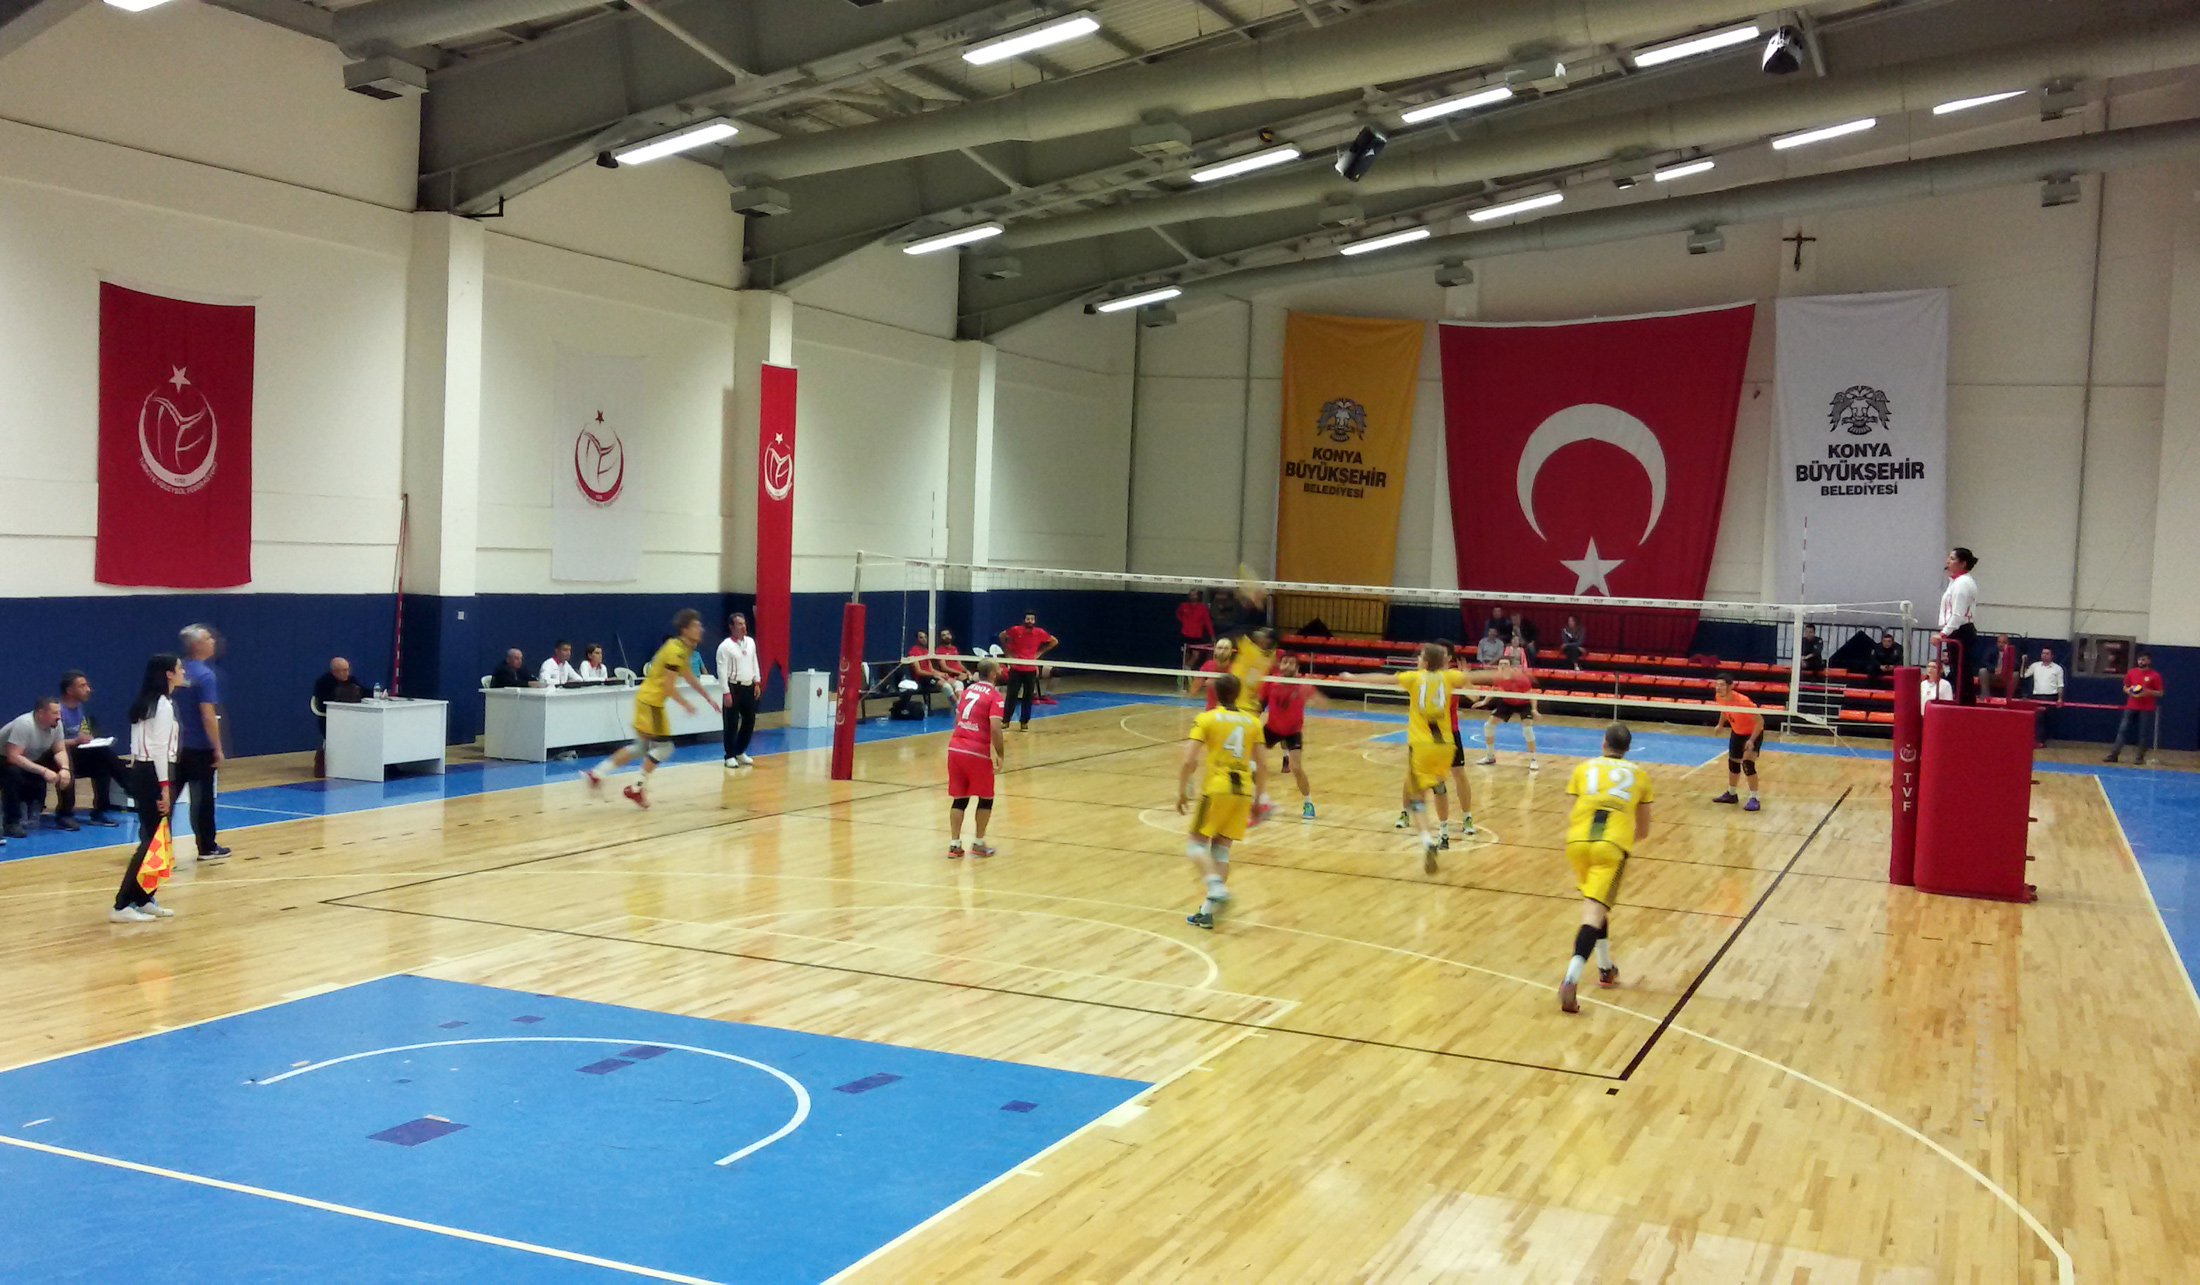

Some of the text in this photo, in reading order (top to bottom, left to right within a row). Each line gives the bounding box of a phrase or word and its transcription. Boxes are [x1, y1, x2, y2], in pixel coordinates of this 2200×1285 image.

[1312, 447, 1362, 464] KONYA
[1828, 443, 1892, 458] KONYA
[1285, 460, 1387, 487] BÜYÜKŞEHİR
[1796, 458, 1925, 483] BÜYÜKŞEHİR
[1303, 482, 1364, 499] BELEDİYESİ
[1821, 481, 1898, 496] BELEDİYESİ
[838, 675, 846, 707] TVF
[962, 690, 981, 720] 7
[1418, 681, 1446, 710] 14
[1222, 724, 1245, 759] 4
[1585, 766, 1635, 801] 12
[1902, 772, 1912, 812] TVF
